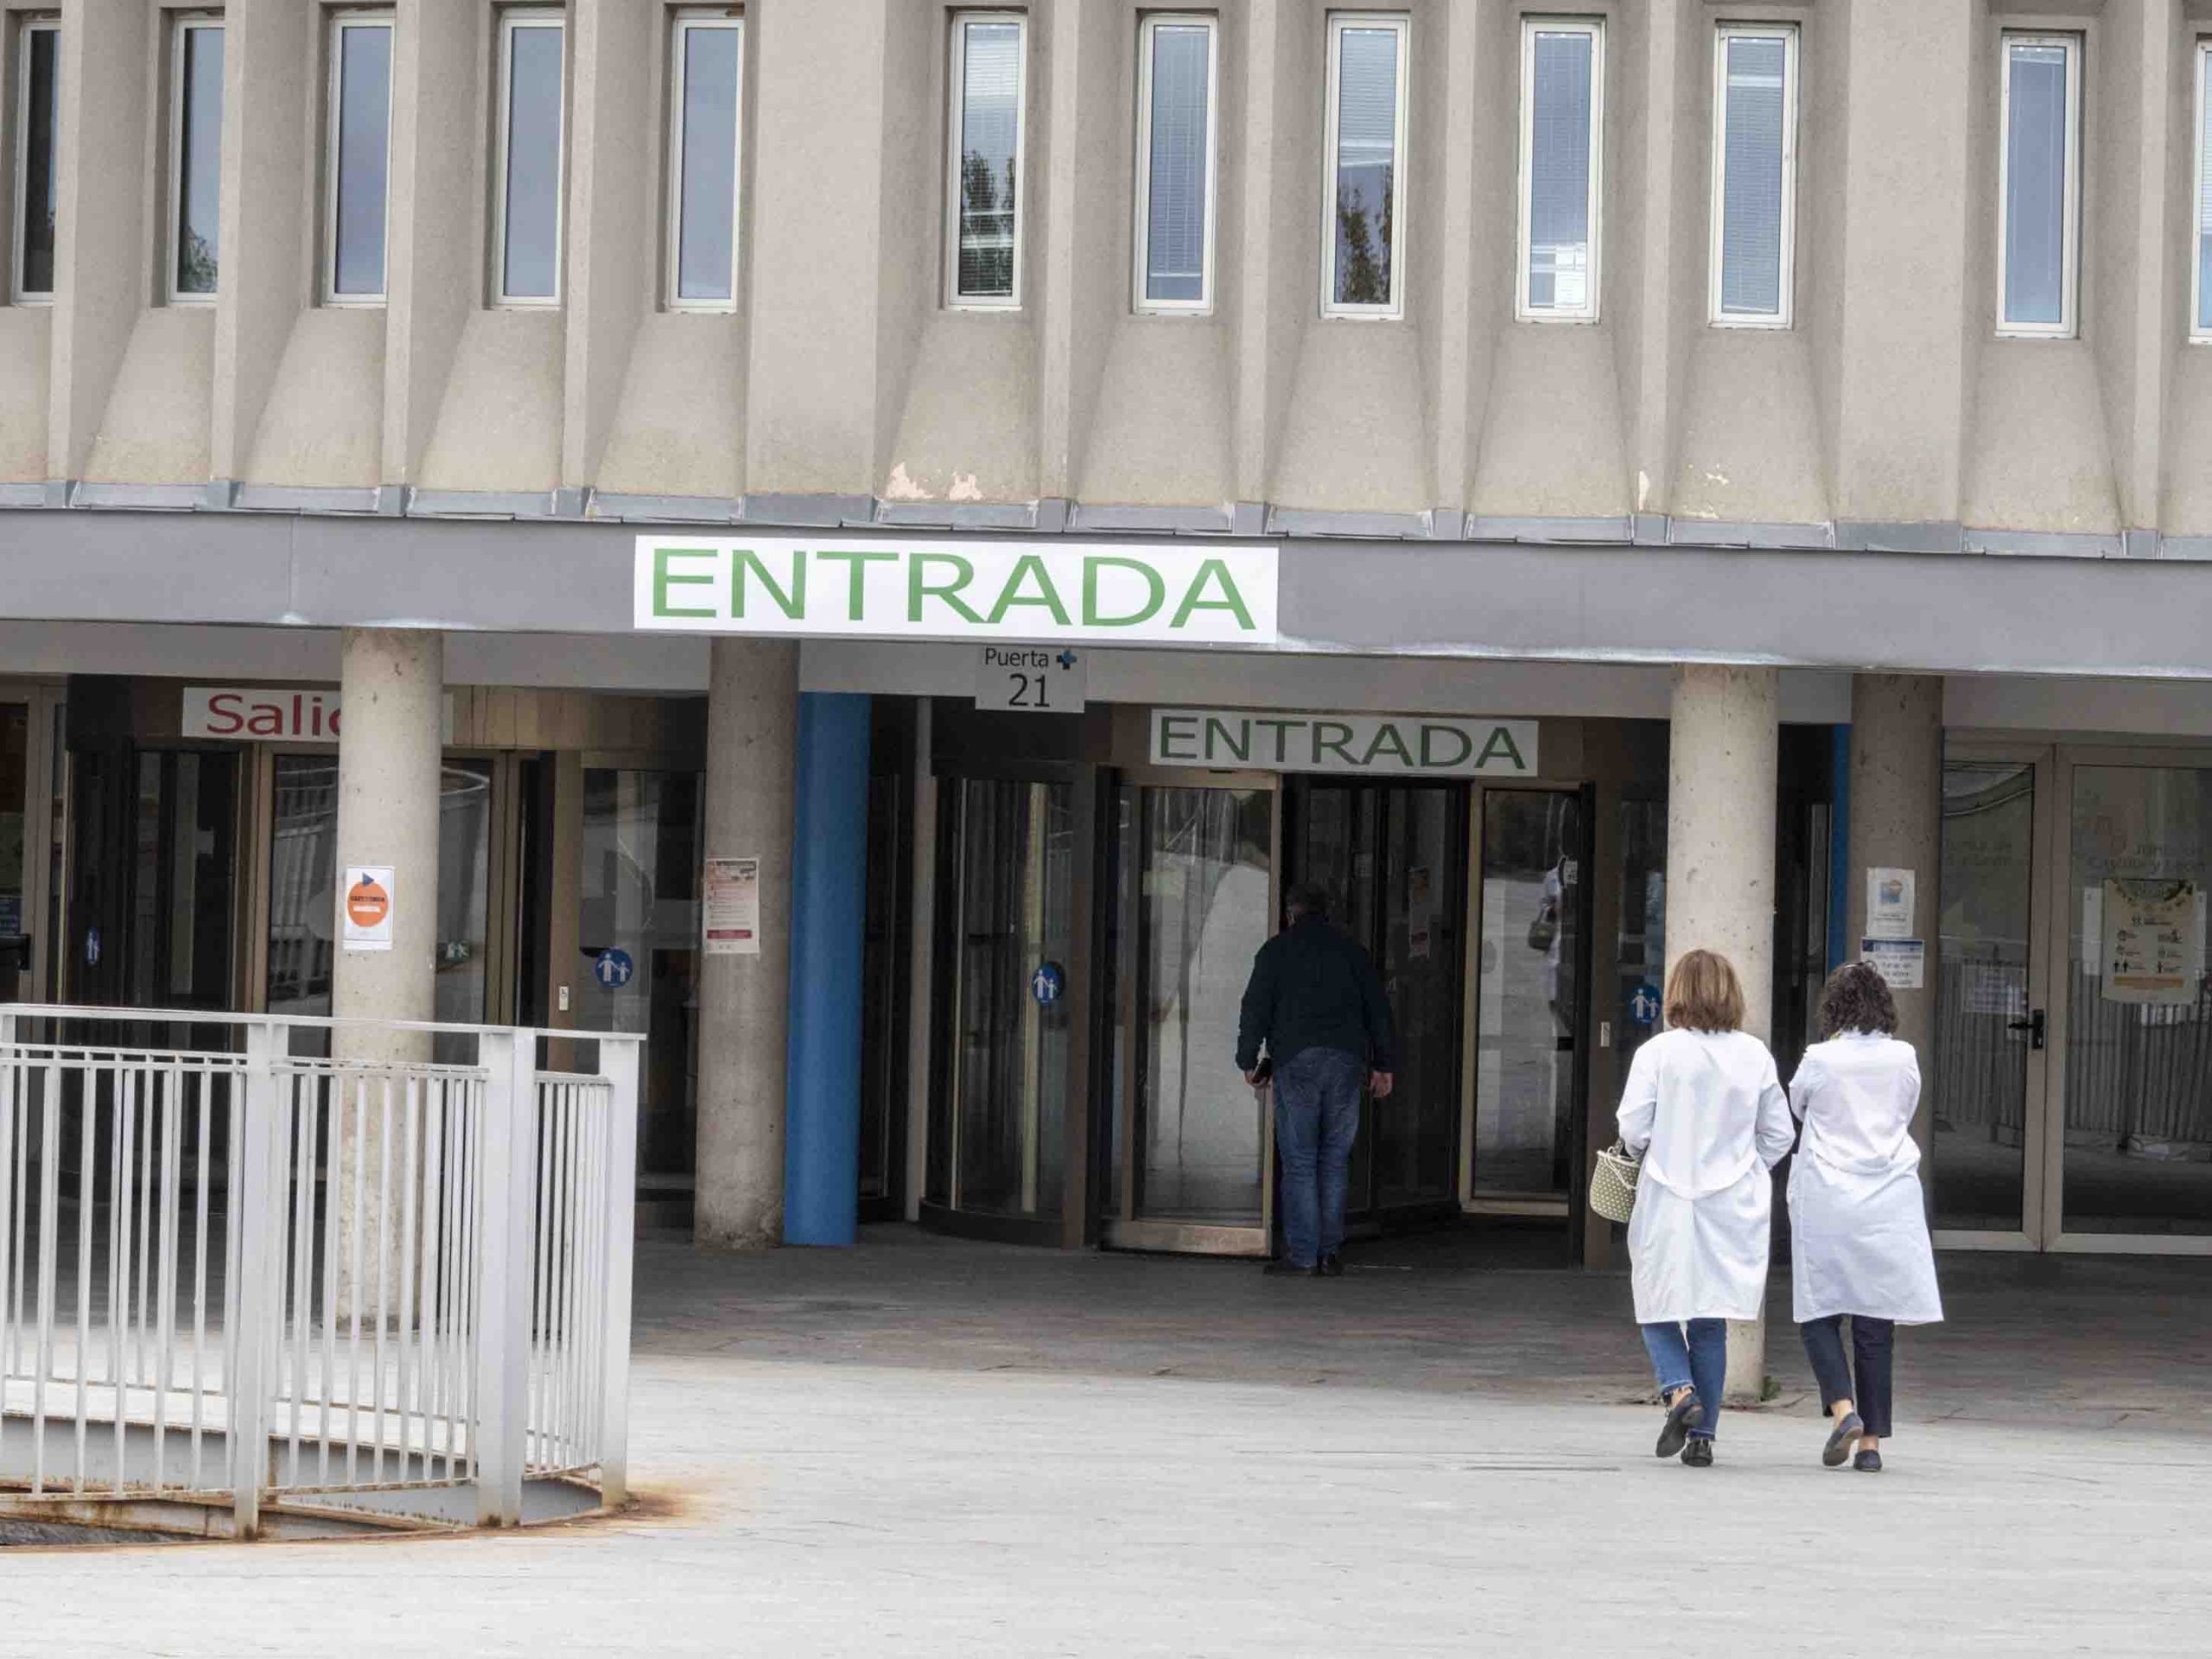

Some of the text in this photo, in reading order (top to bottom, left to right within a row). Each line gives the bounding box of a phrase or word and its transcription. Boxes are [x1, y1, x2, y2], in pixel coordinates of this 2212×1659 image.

[652, 548, 1257, 630] ENTRADA
[985, 647, 1049, 667] Puerta
[1008, 673, 1051, 708] 21
[207, 694, 342, 736] Sali
[1160, 716, 1527, 770] ENTRADA
